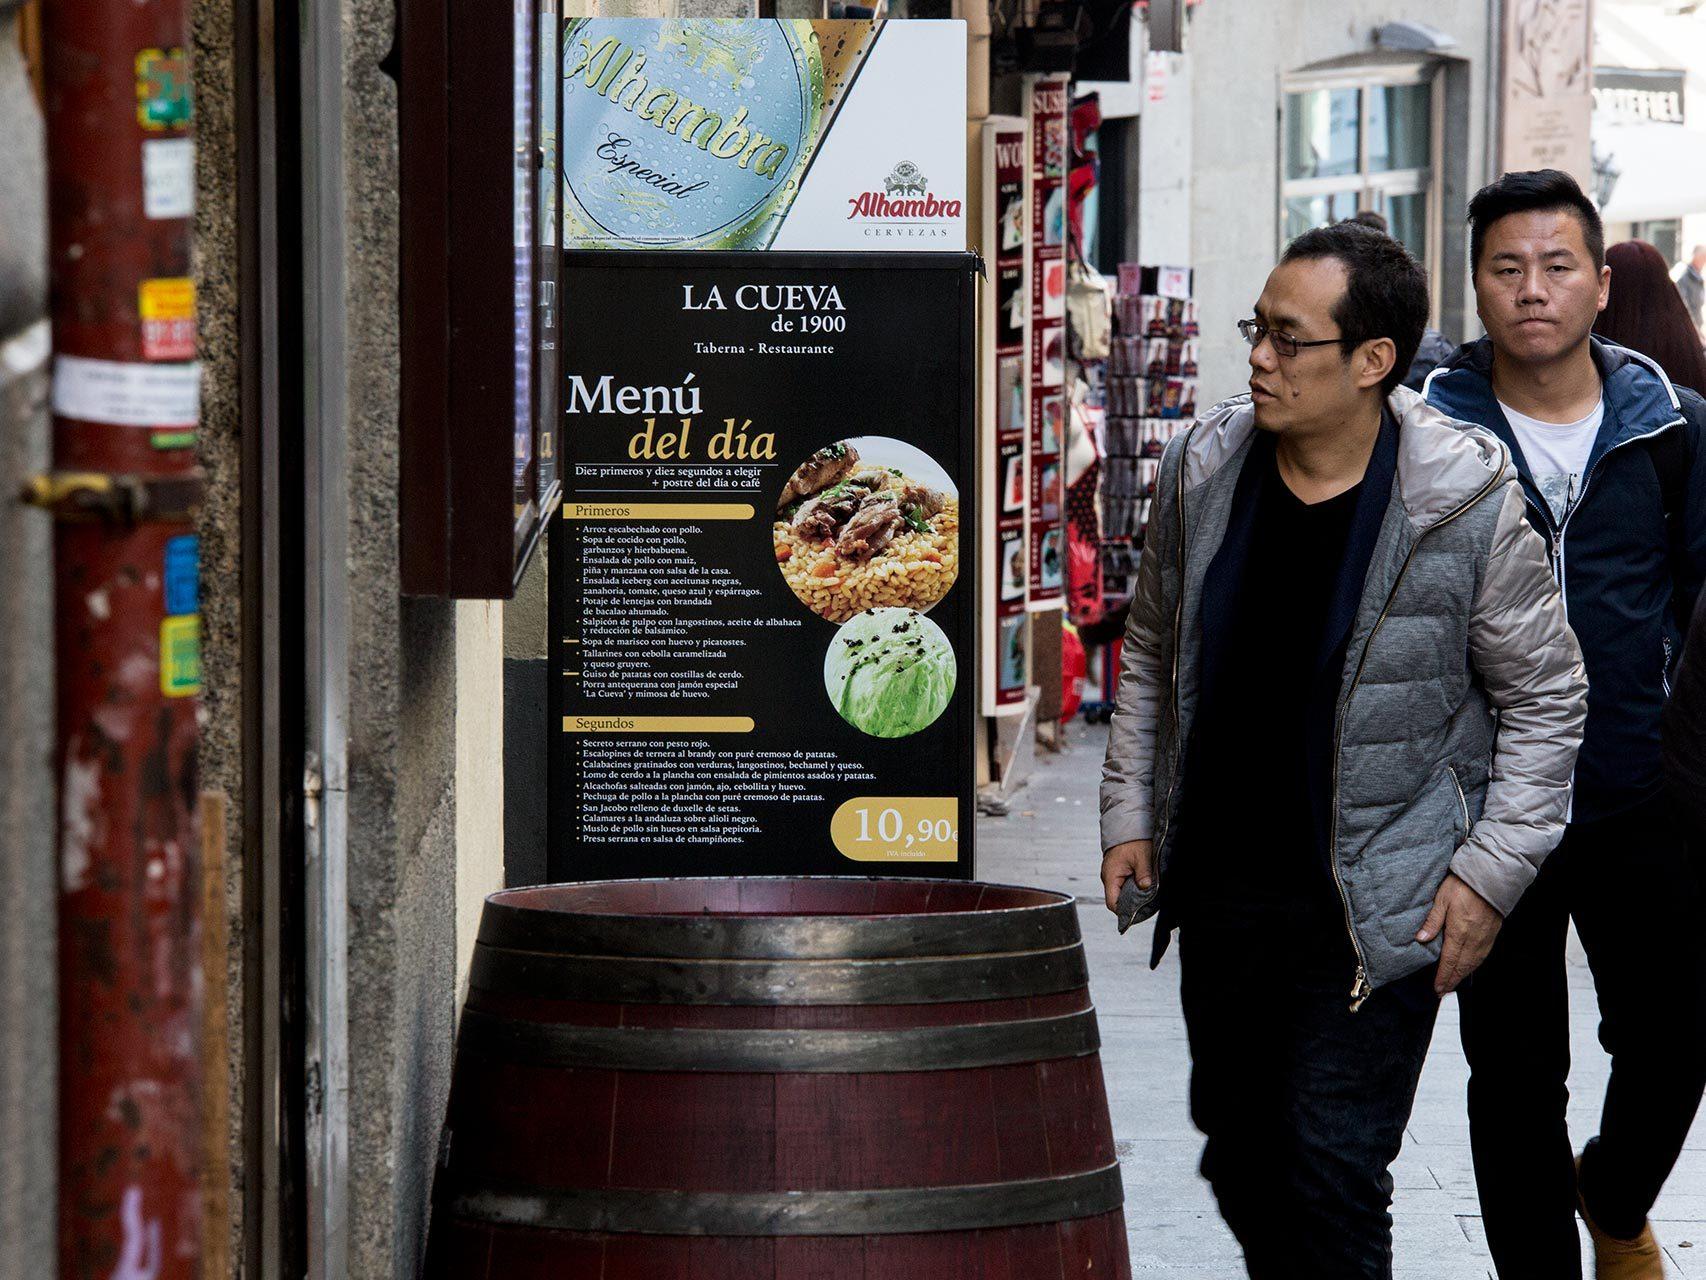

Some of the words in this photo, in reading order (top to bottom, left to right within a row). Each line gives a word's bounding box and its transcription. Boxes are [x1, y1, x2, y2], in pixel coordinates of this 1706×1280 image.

[564, 35, 789, 181] Alhambra
[596, 132, 710, 199] Especial
[847, 192, 961, 220] Alhambra
[682, 285, 727, 310] LA
[735, 284, 846, 311] CUEVA
[771, 314, 794, 332] de
[800, 315, 846, 334] 1900
[694, 342, 746, 354] Taberna
[758, 342, 834, 354] Restaurante
[566, 372, 703, 415] Menú
[628, 417, 692, 460] del
[707, 417, 777, 460] día
[575, 466, 598, 476] Diez
[600, 467, 644, 478] primeros
[646, 468, 652, 478] y
[654, 466, 675, 476] diez
[677, 466, 723, 478] segundos
[725, 468, 732, 476] a
[734, 466, 762, 478] elegir
[663, 479, 693, 489] postre
[696, 478, 711, 487] del
[714, 478, 729, 487] día
[731, 479, 738, 487] o
[740, 478, 761, 487] café
[575, 505, 630, 516] Primeros
[583, 525, 606, 533] Arroz
[609, 525, 660, 533] escabechado
[680, 525, 702, 535] pollo.
[583, 535, 602, 545] Sopa
[605, 535, 615, 543] de
[617, 535, 644, 543] cocido
[663, 535, 686, 545] pollo,
[583, 546, 625, 556] garbanzos
[635, 546, 687, 554] hierbabuena.
[583, 556, 619, 564] Ensalada
[622, 556, 631, 564] de
[634, 556, 655, 566] pollo
[584, 566, 601, 576] piña
[667, 566, 687, 574] salsa
[689, 566, 699, 574] de
[702, 566, 709, 574] la
[583, 576, 619, 584] Ensalada
[622, 576, 651, 586] iceberg
[671, 576, 709, 584] aceitunas
[712, 578, 741, 586] negras,
[584, 587, 626, 596] zanahoria,
[629, 587, 659, 596] tomate,
[662, 589, 686, 597] queso
[689, 587, 705, 595] azul
[715, 588, 762, 597] espárragos.
[583, 597, 608, 607] Potaje
[610, 597, 620, 605] de
[623, 597, 654, 607] lentejas
[674, 597, 712, 605] brandada
[583, 607, 593, 615] de
[596, 607, 626, 615] bacalao
[629, 607, 669, 615] ahumado.
[582, 637, 602, 647] Sopa
[604, 637, 614, 645] de
[617, 637, 649, 645] marisco
[669, 637, 694, 645] huevo
[703, 637, 746, 647] picatostes.
[583, 670, 607, 678] Guiso
[609, 670, 619, 678] de
[622, 670, 651, 680] patatas
[671, 670, 704, 678] costillas
[706, 670, 716, 678] de
[719, 670, 744, 678] cerdo.
[583, 680, 605, 688] Porra
[608, 680, 658, 690] antequerana
[678, 680, 703, 690] jamón
[705, 680, 738, 690] especial
[576, 718, 634, 732] Segundos
[583, 739, 614, 747] Secreto
[667, 739, 689, 749] pesto
[691, 739, 710, 749] rojo.
[583, 760, 631, 768] Calabacines
[634, 760, 677, 770] gratinados
[697, 760, 734, 769] verduras,
[737, 761, 786, 770] langostinos,
[837, 763, 864, 771] queso.
[583, 782, 627, 790] Alcachofas
[630, 782, 667, 790] salteadas
[687, 782, 714, 792] jamón,
[717, 782, 731, 792] ajo,
[583, 804, 598, 812] San
[600, 804, 628, 812] Jacobo
[630, 804, 659, 812] relleno
[661, 804, 671, 812] de
[673, 804, 703, 812] duxelle
[705, 804, 715, 812] de
[718, 804, 741, 812] setas.
[583, 814, 625, 822] Calamares
[635, 814, 642, 822] la
[645, 814, 681, 822] andaluza
[684, 814, 706, 822] sobre
[708, 814, 729, 822] alioli
[583, 824, 608, 832] Muslo
[611, 824, 620, 832] de
[623, 824, 644, 834] pollo
[647, 824, 658, 832] sin
[661, 824, 685, 832] hueso
[700, 824, 720, 832] salsa
[723, 825, 762, 834] pepitoria.
[583, 834, 605, 842] Presa
[653, 834, 673, 842] salsa
[675, 834, 685, 842] de
